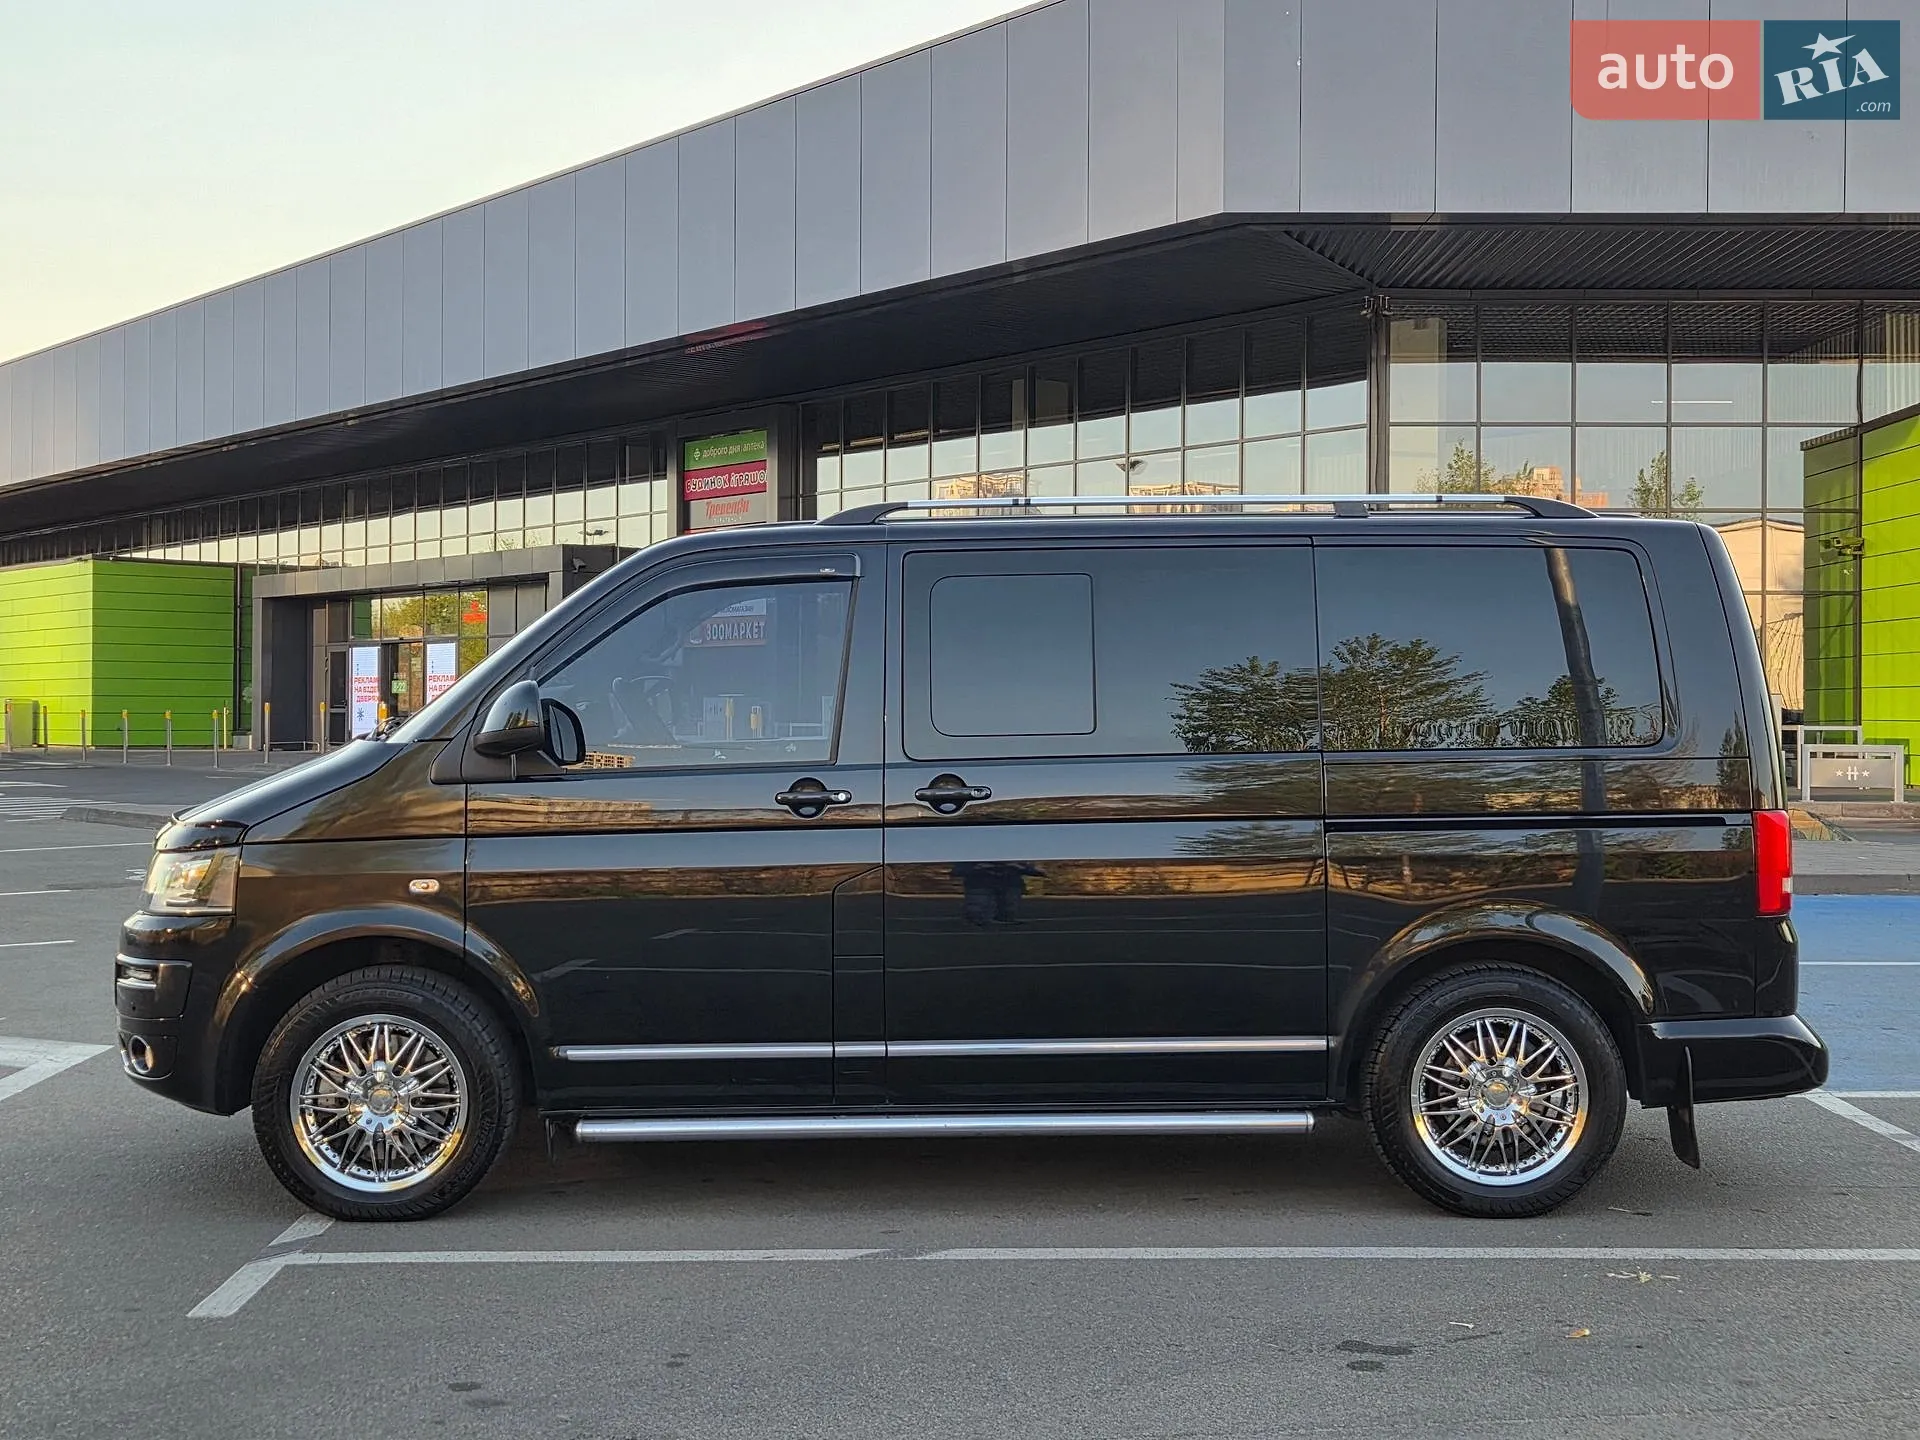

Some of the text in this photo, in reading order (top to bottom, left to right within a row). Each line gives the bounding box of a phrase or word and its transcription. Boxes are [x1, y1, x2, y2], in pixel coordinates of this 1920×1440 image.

[702, 445, 728, 459] доброго
[686, 473, 729, 493] БУДИНОК
[705, 621, 765, 640] ЗООМАРКЕТ
